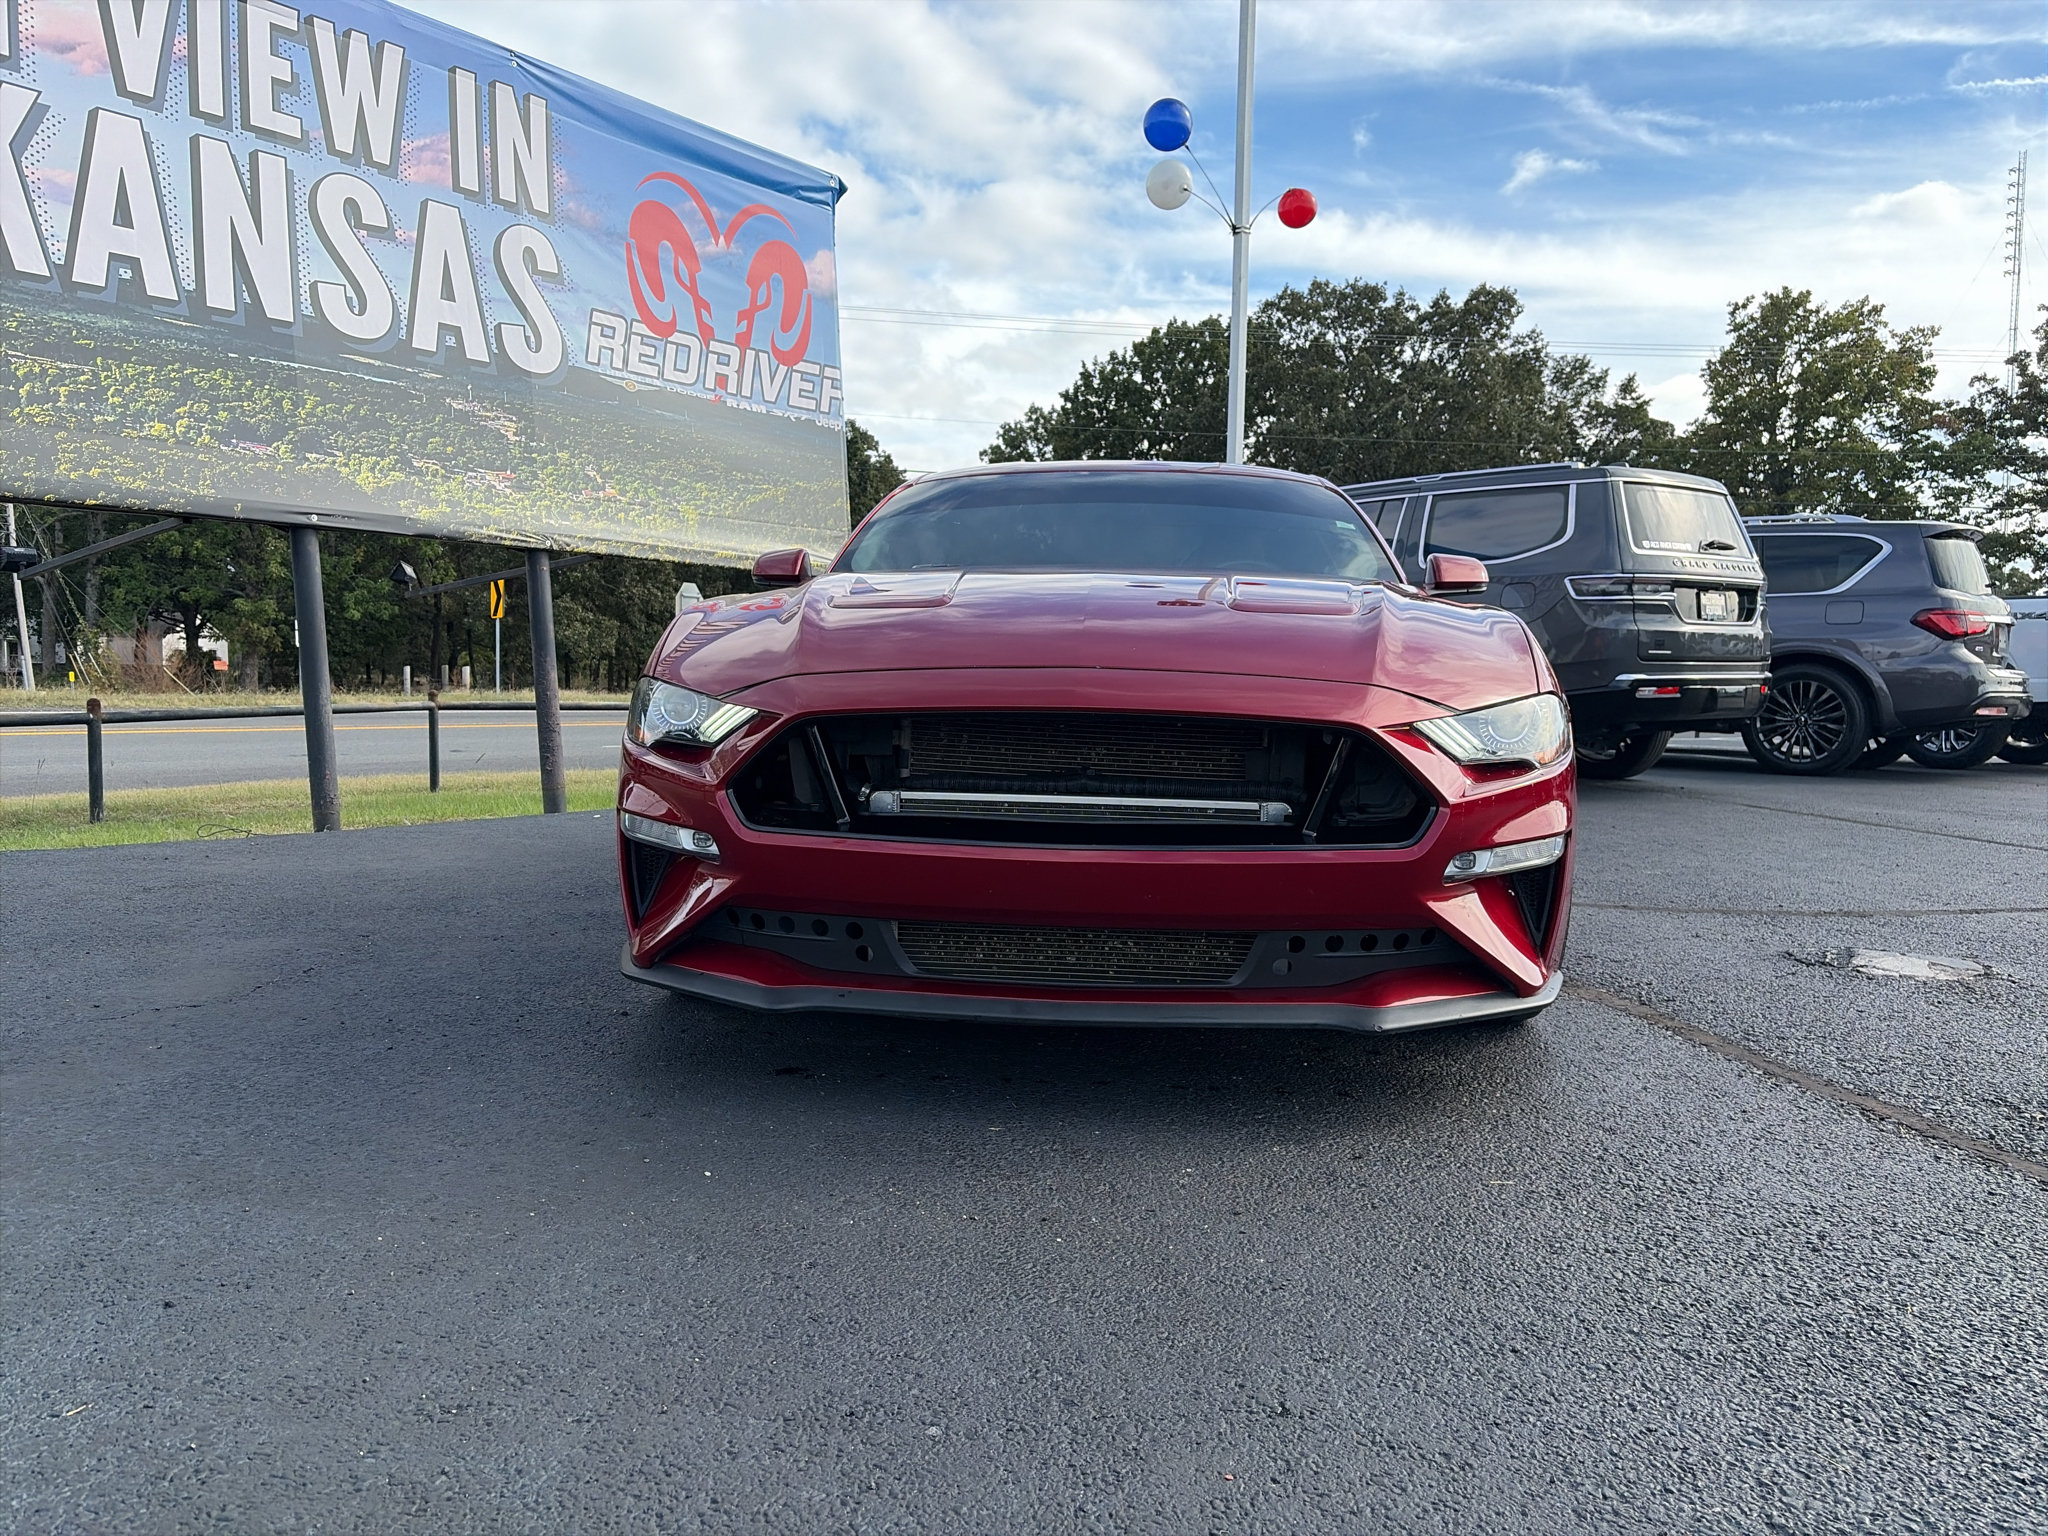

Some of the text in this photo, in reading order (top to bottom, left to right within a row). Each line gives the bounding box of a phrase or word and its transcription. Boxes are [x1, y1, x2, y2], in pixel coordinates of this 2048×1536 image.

[97, 0, 550, 216] VIEW IN
[726, 398, 767, 414] RAM
[815, 414, 842, 432] Jeep
